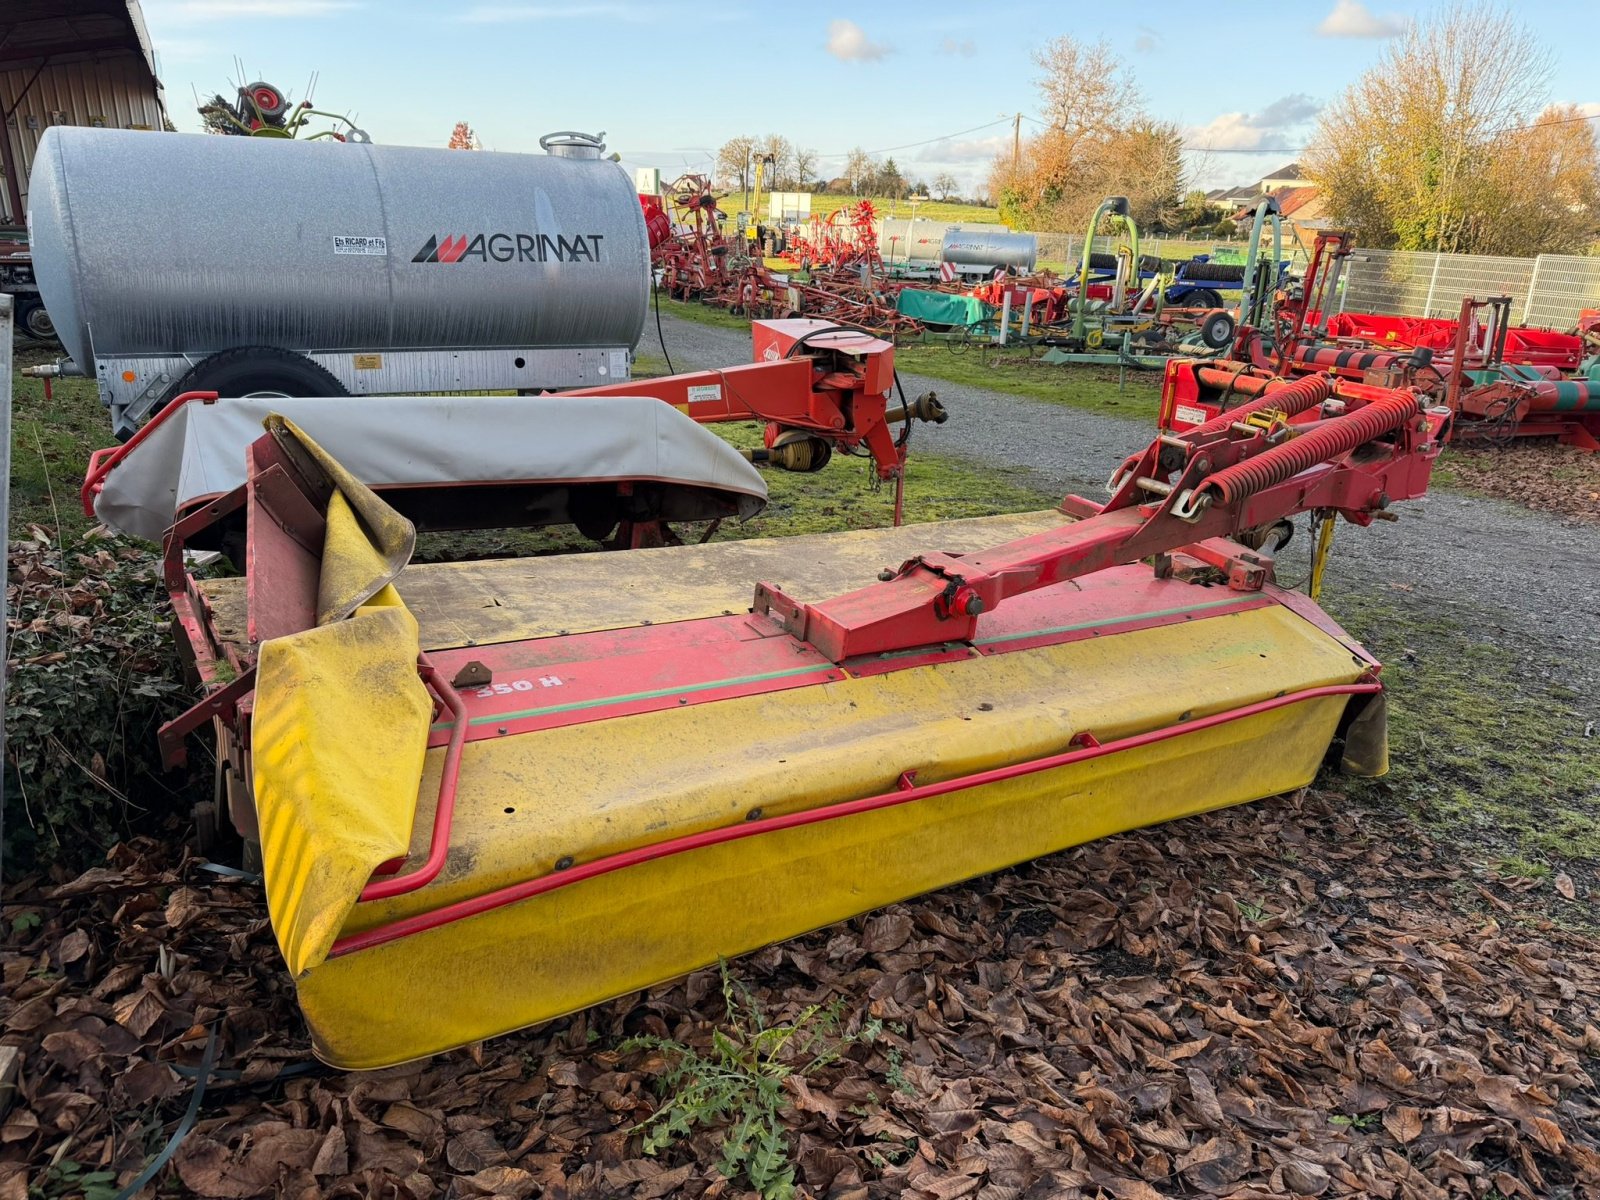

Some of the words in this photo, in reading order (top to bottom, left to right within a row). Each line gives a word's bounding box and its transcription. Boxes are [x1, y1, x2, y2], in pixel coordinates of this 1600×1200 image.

[335, 237, 344, 246] Ets
[345, 237, 368, 247] RICARD
[456, 233, 604, 262] AGRIMAT
[477, 680, 533, 698] 350
[539, 676, 563, 687] H
